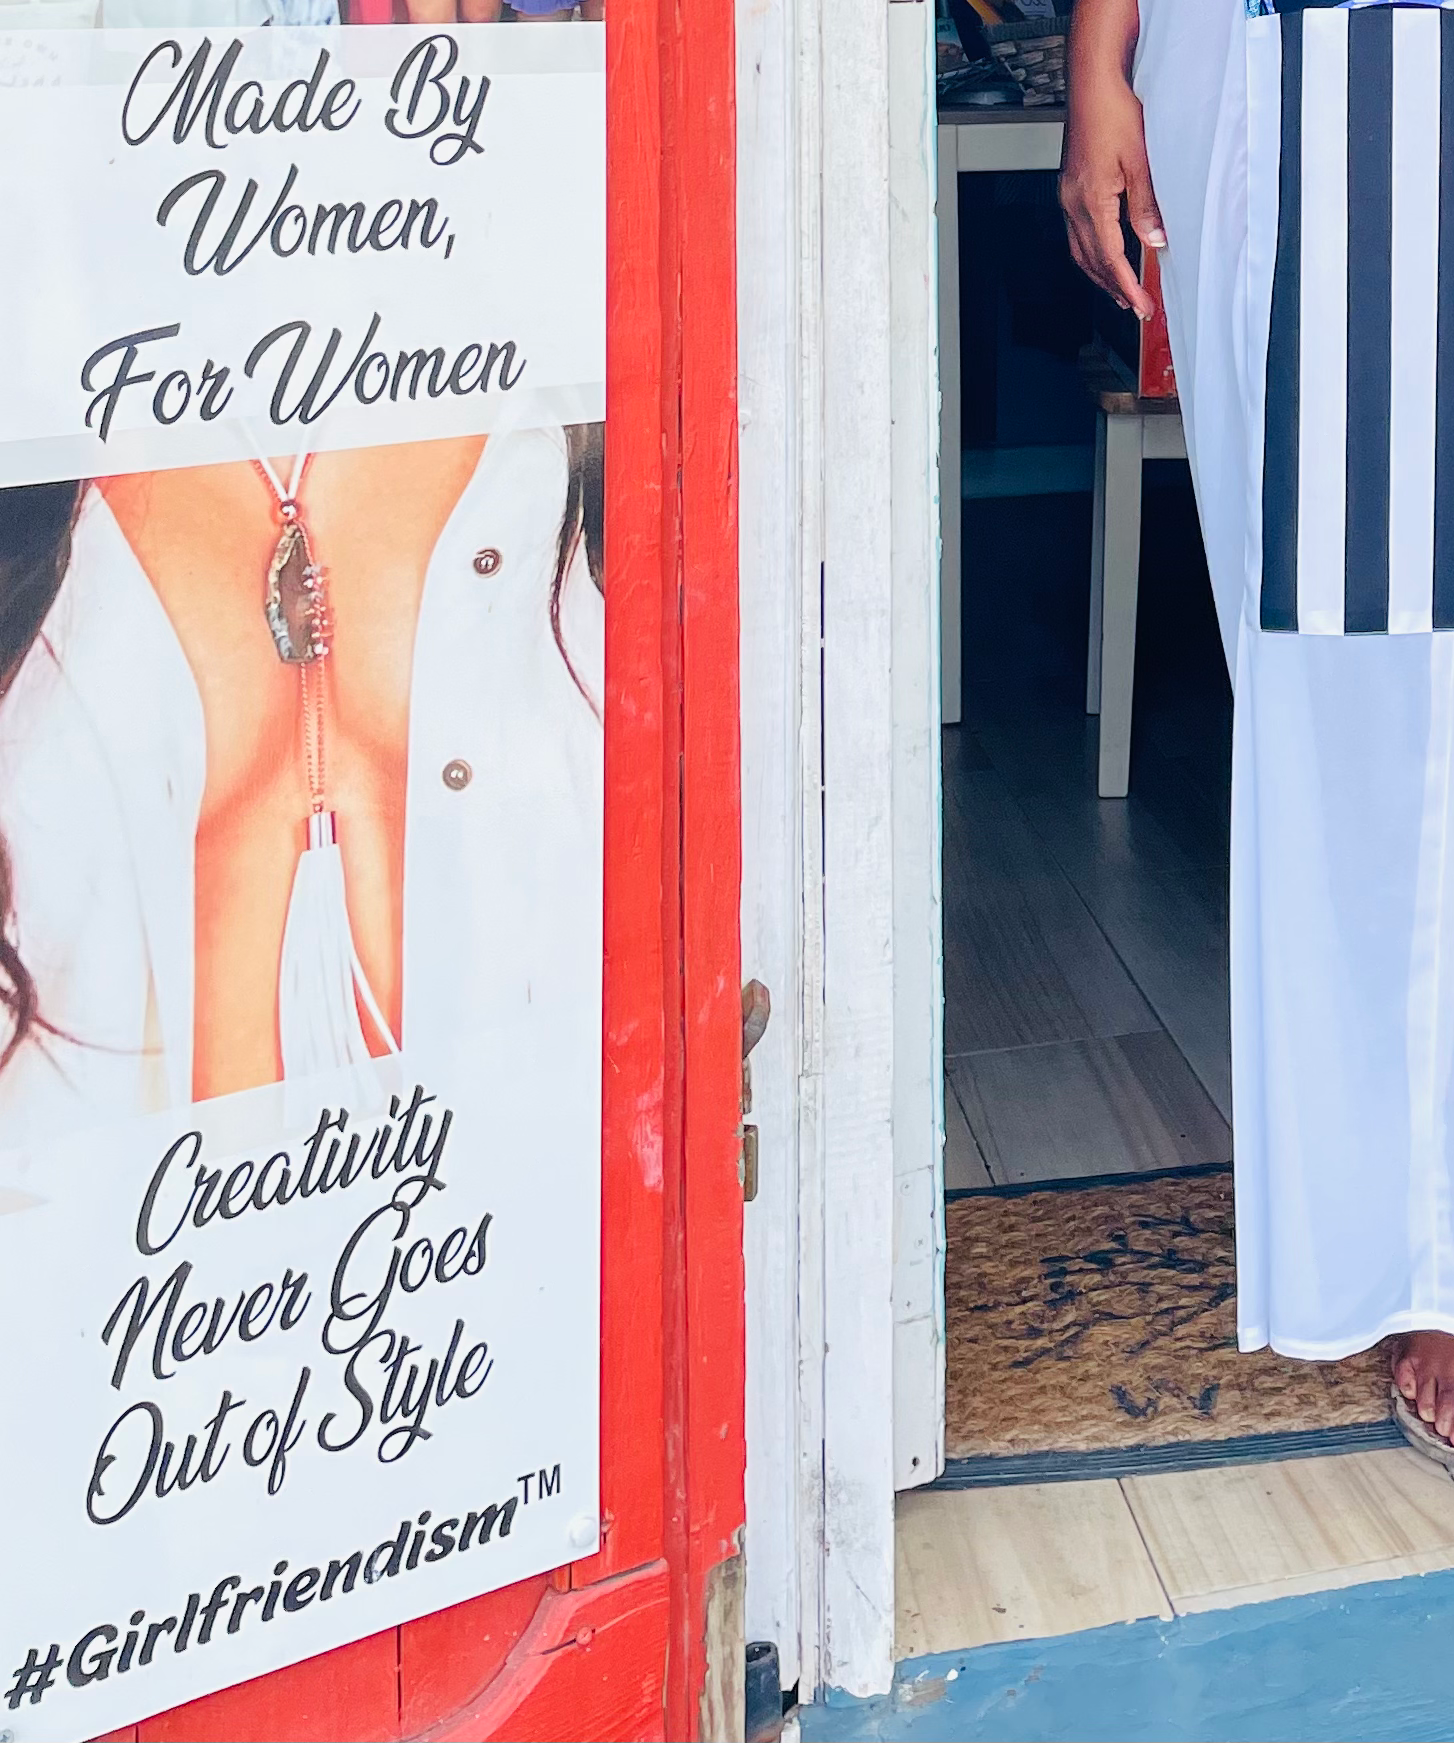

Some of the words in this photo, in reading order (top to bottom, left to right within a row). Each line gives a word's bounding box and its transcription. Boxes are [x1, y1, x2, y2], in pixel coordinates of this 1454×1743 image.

[122, 36, 361, 150] Made
[384, 34, 491, 166] By
[156, 163, 456, 277] Women,
[81, 322, 234, 444] For
[243, 311, 527, 426] Women
[136, 1084, 454, 1256] Creativity
[101, 1260, 312, 1391] Never
[322, 1201, 494, 1356] Goes
[86, 1390, 246, 1526] Out
[242, 1366, 312, 1496] of
[317, 1318, 494, 1464] Style
